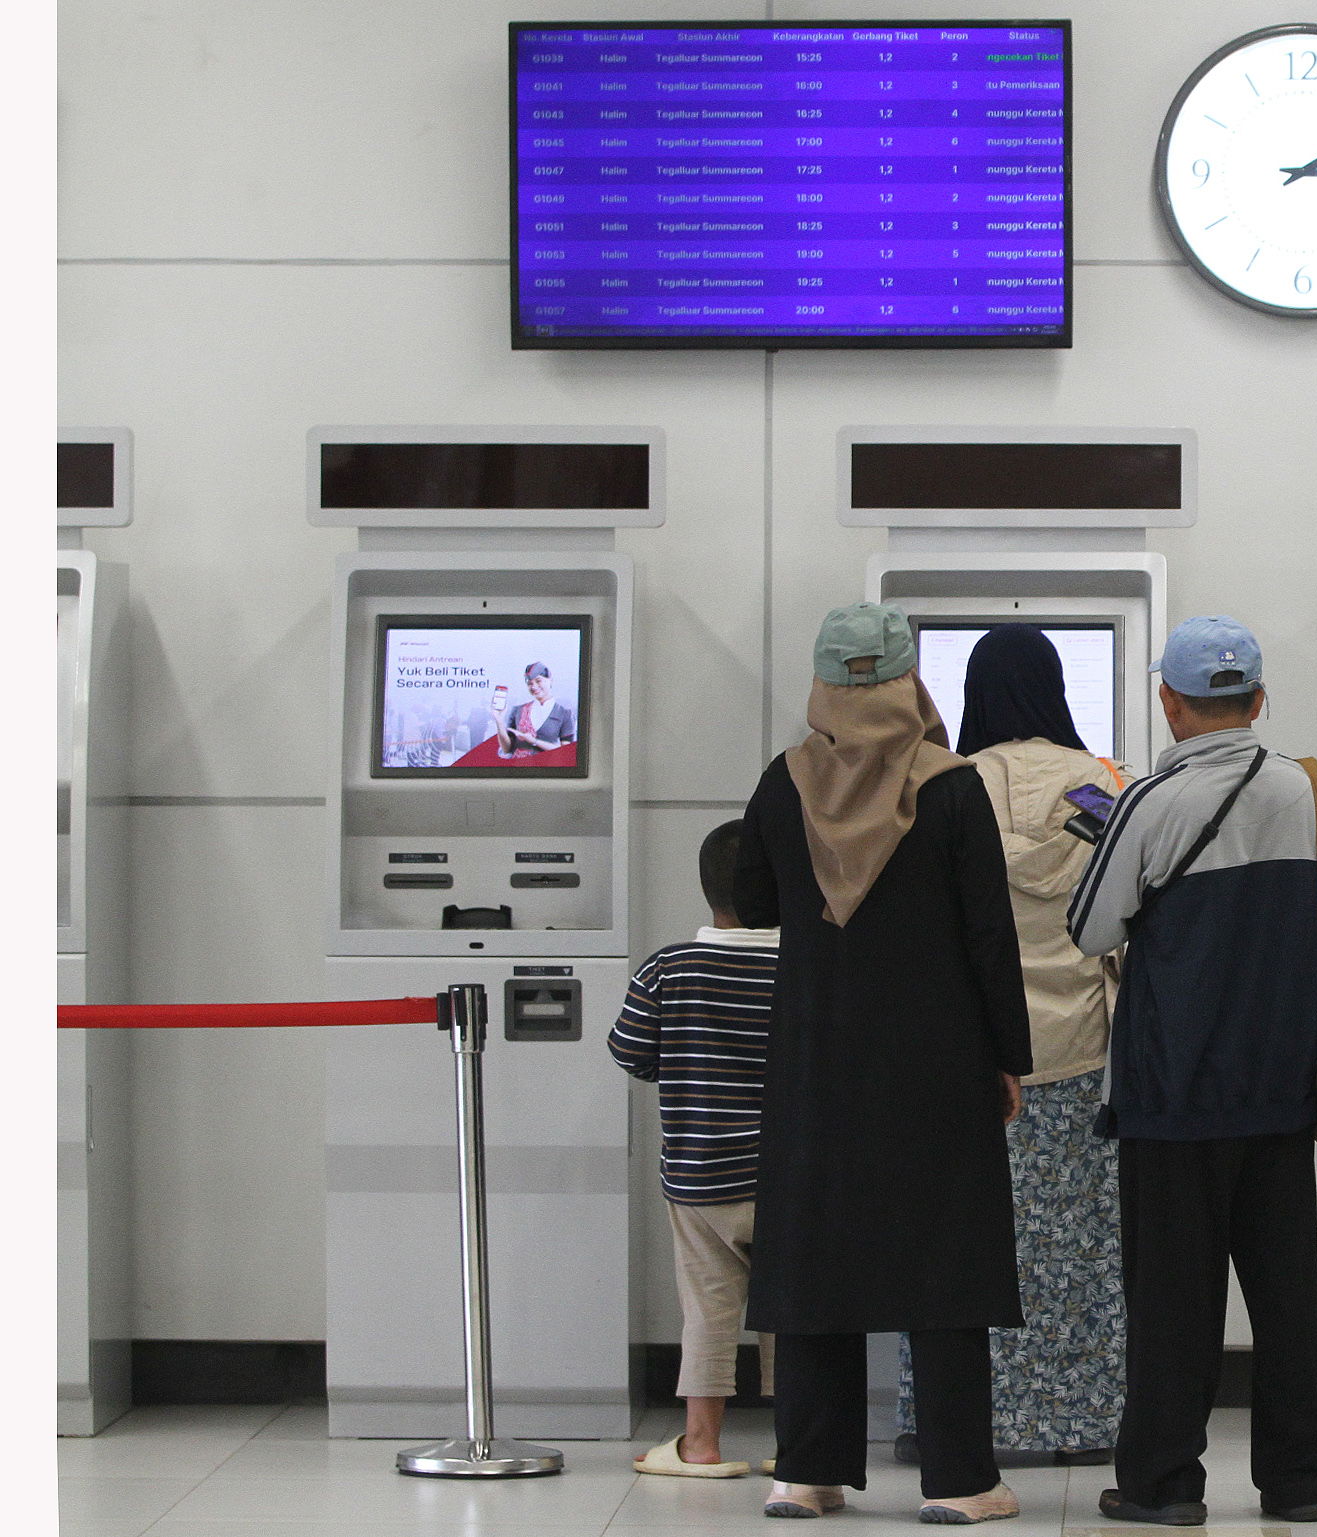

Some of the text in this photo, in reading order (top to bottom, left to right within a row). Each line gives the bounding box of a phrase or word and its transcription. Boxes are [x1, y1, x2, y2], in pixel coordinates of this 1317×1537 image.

[583, 33, 643, 41] Stasiun Awal
[678, 32, 740, 40] Stasiun Akhir
[773, 33, 844, 41] Keberangkatan
[853, 32, 918, 42] Gerbang Tiket
[941, 31, 968, 39] Peron
[1009, 31, 1039, 39] Status
[600, 54, 627, 62] Halim
[702, 54, 762, 62] Summarecon
[797, 53, 822, 61] 15:25
[879, 53, 892, 62] 1,2
[952, 53, 958, 61] 2
[986, 52, 1059, 62] ngecekan Tiket
[1284, 51, 1317, 80] 12
[600, 82, 627, 90] Halim
[702, 82, 763, 90] Summarecon
[796, 81, 822, 89] 16:00
[880, 81, 892, 90] 1,2
[952, 81, 958, 89] 3
[1000, 80, 1060, 88] Pemeriksaan
[600, 110, 627, 118] Halim
[702, 110, 763, 118] Summarecon
[797, 109, 822, 118] 16:25
[880, 109, 892, 118] 1,2
[952, 109, 958, 117] 4
[986, 110, 1023, 119] nunggu
[1026, 109, 1056, 117] Kereta
[601, 138, 627, 146] Halim
[702, 138, 763, 146] Summarecon
[797, 138, 822, 146] 17:00
[880, 138, 892, 146] 1,2
[952, 137, 958, 145] 6
[987, 137, 1057, 147] nunggu Kereta
[601, 166, 627, 174] Halim
[702, 166, 763, 174] Summarecon
[797, 166, 822, 174] 17:25
[880, 166, 892, 175] 1,2
[952, 165, 958, 173] 1
[986, 165, 1057, 175] nunggu Kereta
[1192, 159, 1210, 188] 9
[601, 195, 627, 203] Halim
[703, 194, 763, 202] Summarecon
[797, 194, 823, 202] 18:00
[880, 194, 893, 202] 1,2
[953, 193, 959, 202] 2
[987, 193, 1057, 203] nunggu Kereta
[601, 222, 628, 230] Halim
[702, 222, 763, 230] Summarecon
[797, 222, 822, 230] 18:25
[880, 222, 893, 230] 1,2
[953, 221, 959, 230] 3
[987, 221, 1057, 231] nunggu Kereta
[602, 250, 628, 258] Halim
[703, 250, 764, 258] Summarecon
[797, 250, 823, 258] 19:00
[880, 250, 893, 258] 1,2
[987, 249, 1057, 259] nunggu Kereta
[602, 279, 628, 287] Halim
[703, 278, 763, 286] Summarecon
[798, 278, 823, 286] 19:25
[880, 278, 893, 286] 1,2
[952, 277, 958, 285] 1
[987, 277, 1057, 287] nunggu Kereta
[1294, 265, 1312, 294] 6
[602, 306, 628, 314] Halim
[703, 306, 764, 314] Summarecon
[796, 306, 824, 314] 20:00
[880, 306, 893, 315] 1,2
[988, 305, 1057, 315] nunggu Kereta
[398, 667, 485, 675] Yuk Beli Tiket
[397, 679, 489, 688] Secara Online!
